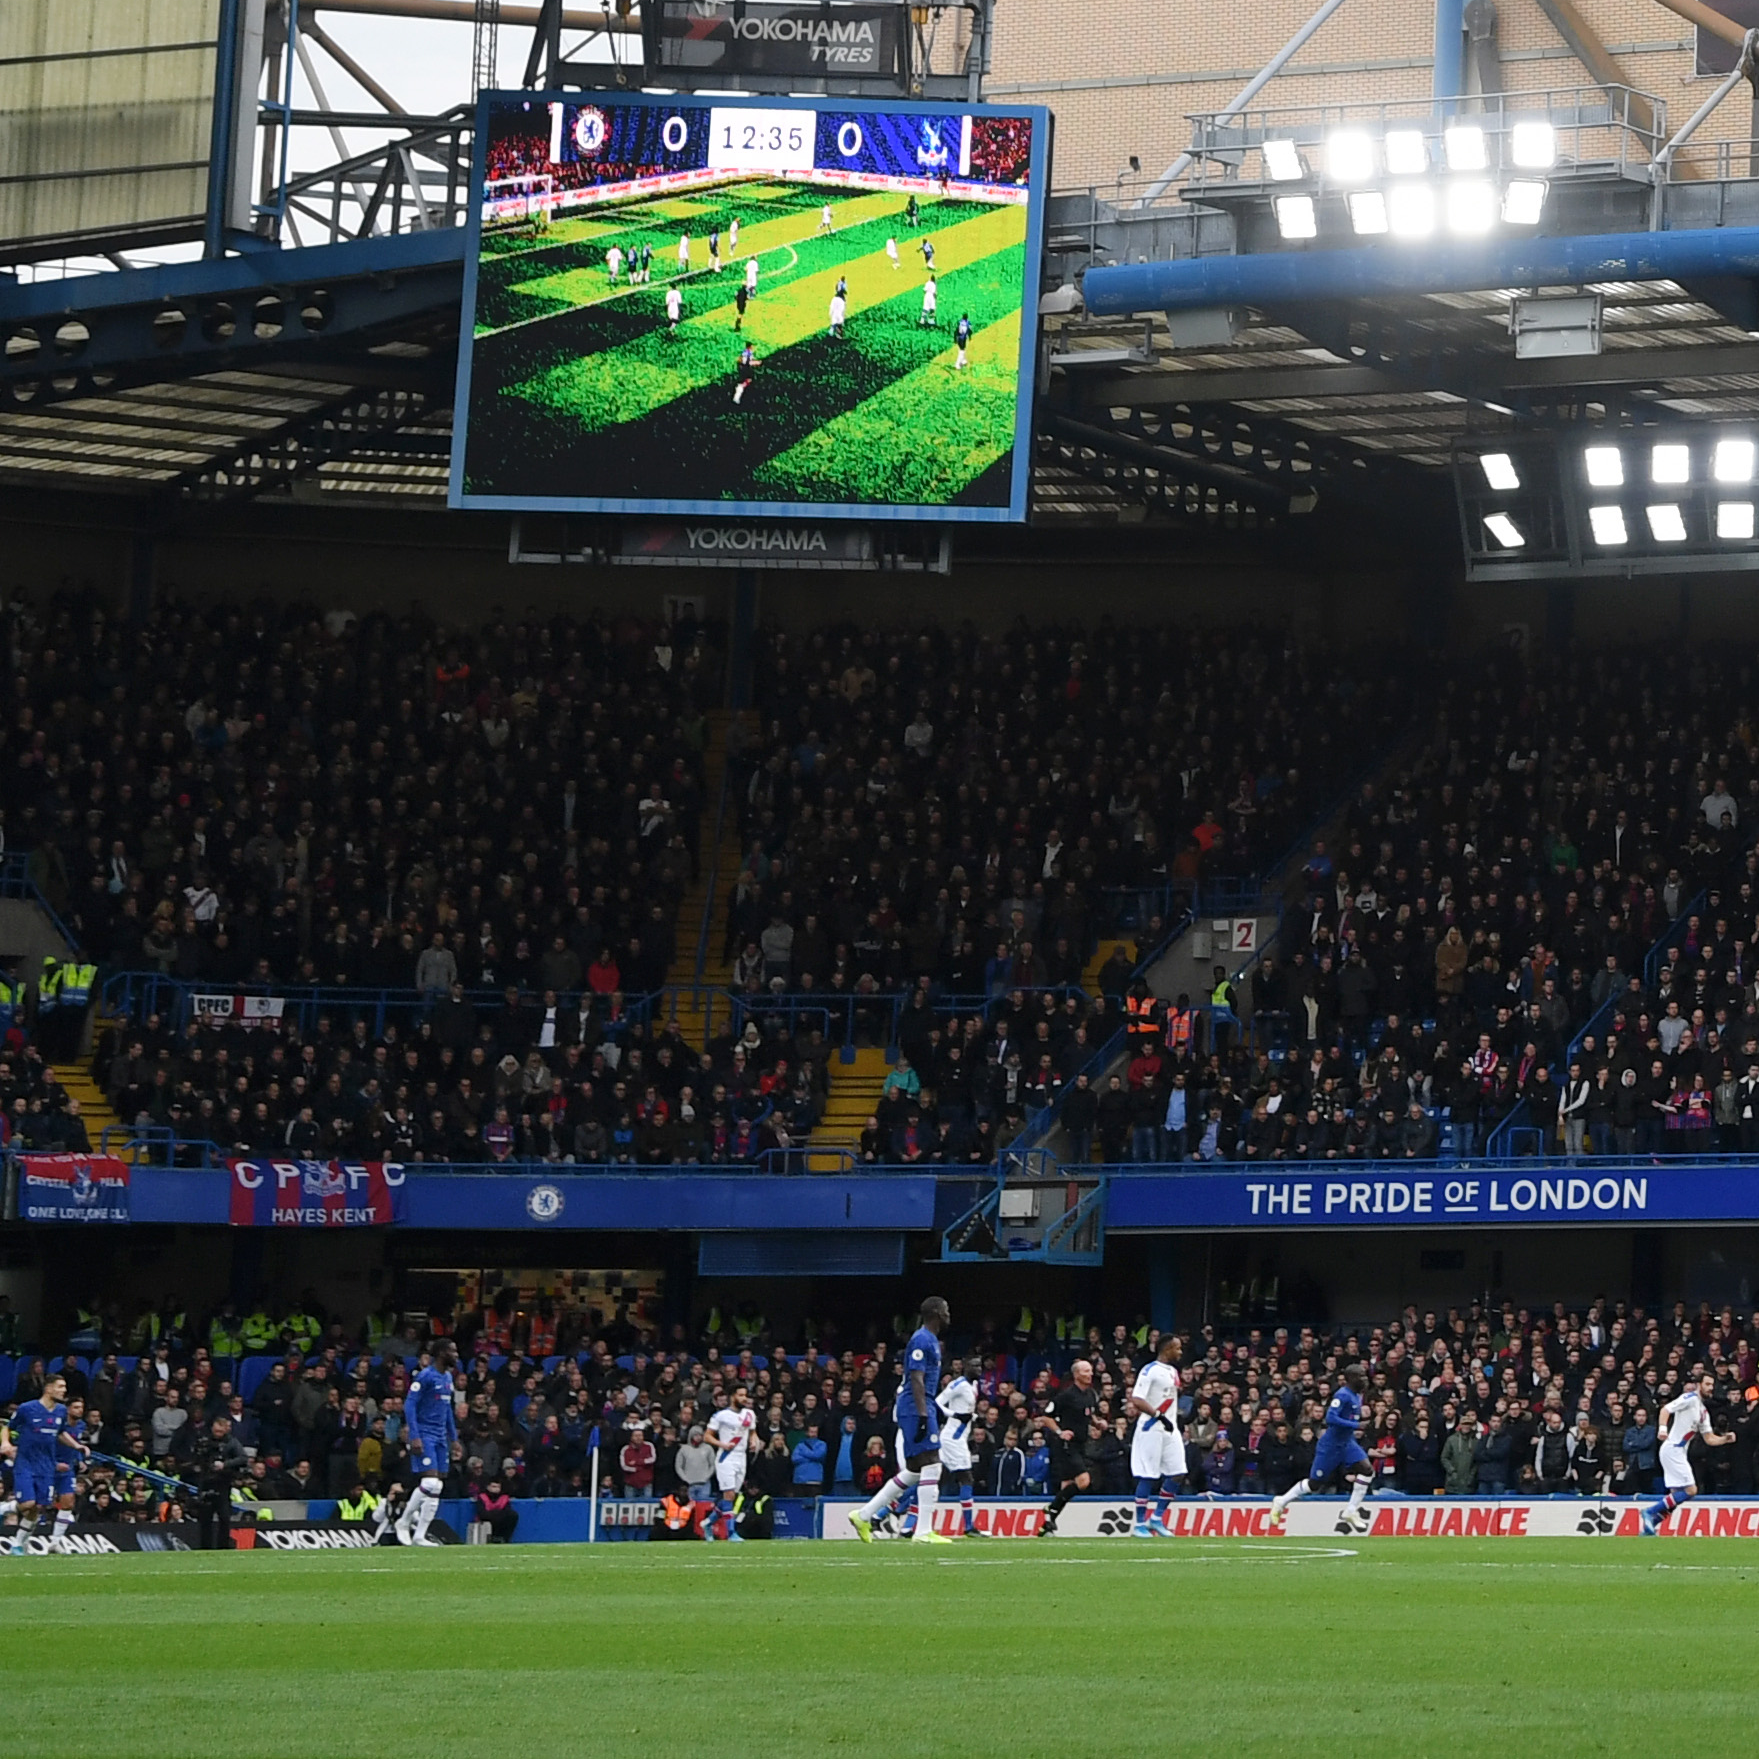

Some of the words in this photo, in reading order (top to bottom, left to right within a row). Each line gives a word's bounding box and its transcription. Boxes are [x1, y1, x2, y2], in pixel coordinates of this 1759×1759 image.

[730, 17, 874, 43] YOKOHAMA
[811, 46, 873, 64] TYRES
[663, 116, 687, 152] 0
[722, 125, 803, 152] 12:35
[837, 121, 862, 158] 0
[686, 527, 827, 552] YOKOHAMA
[1237, 922, 1252, 947] 2
[197, 998, 230, 1013] CPFC
[1246, 1183, 1311, 1216] THE
[1324, 1182, 1432, 1214] PRIDE
[1444, 1180, 1479, 1204] OF
[1489, 1178, 1648, 1212] LONDON
[28, 1206, 57, 1218] ONE
[271, 1208, 328, 1223] HAYES
[332, 1207, 376, 1223] KENT
[1369, 1508, 1530, 1537] ALLIANCE
[257, 1529, 379, 1550] YOKOHAMA
